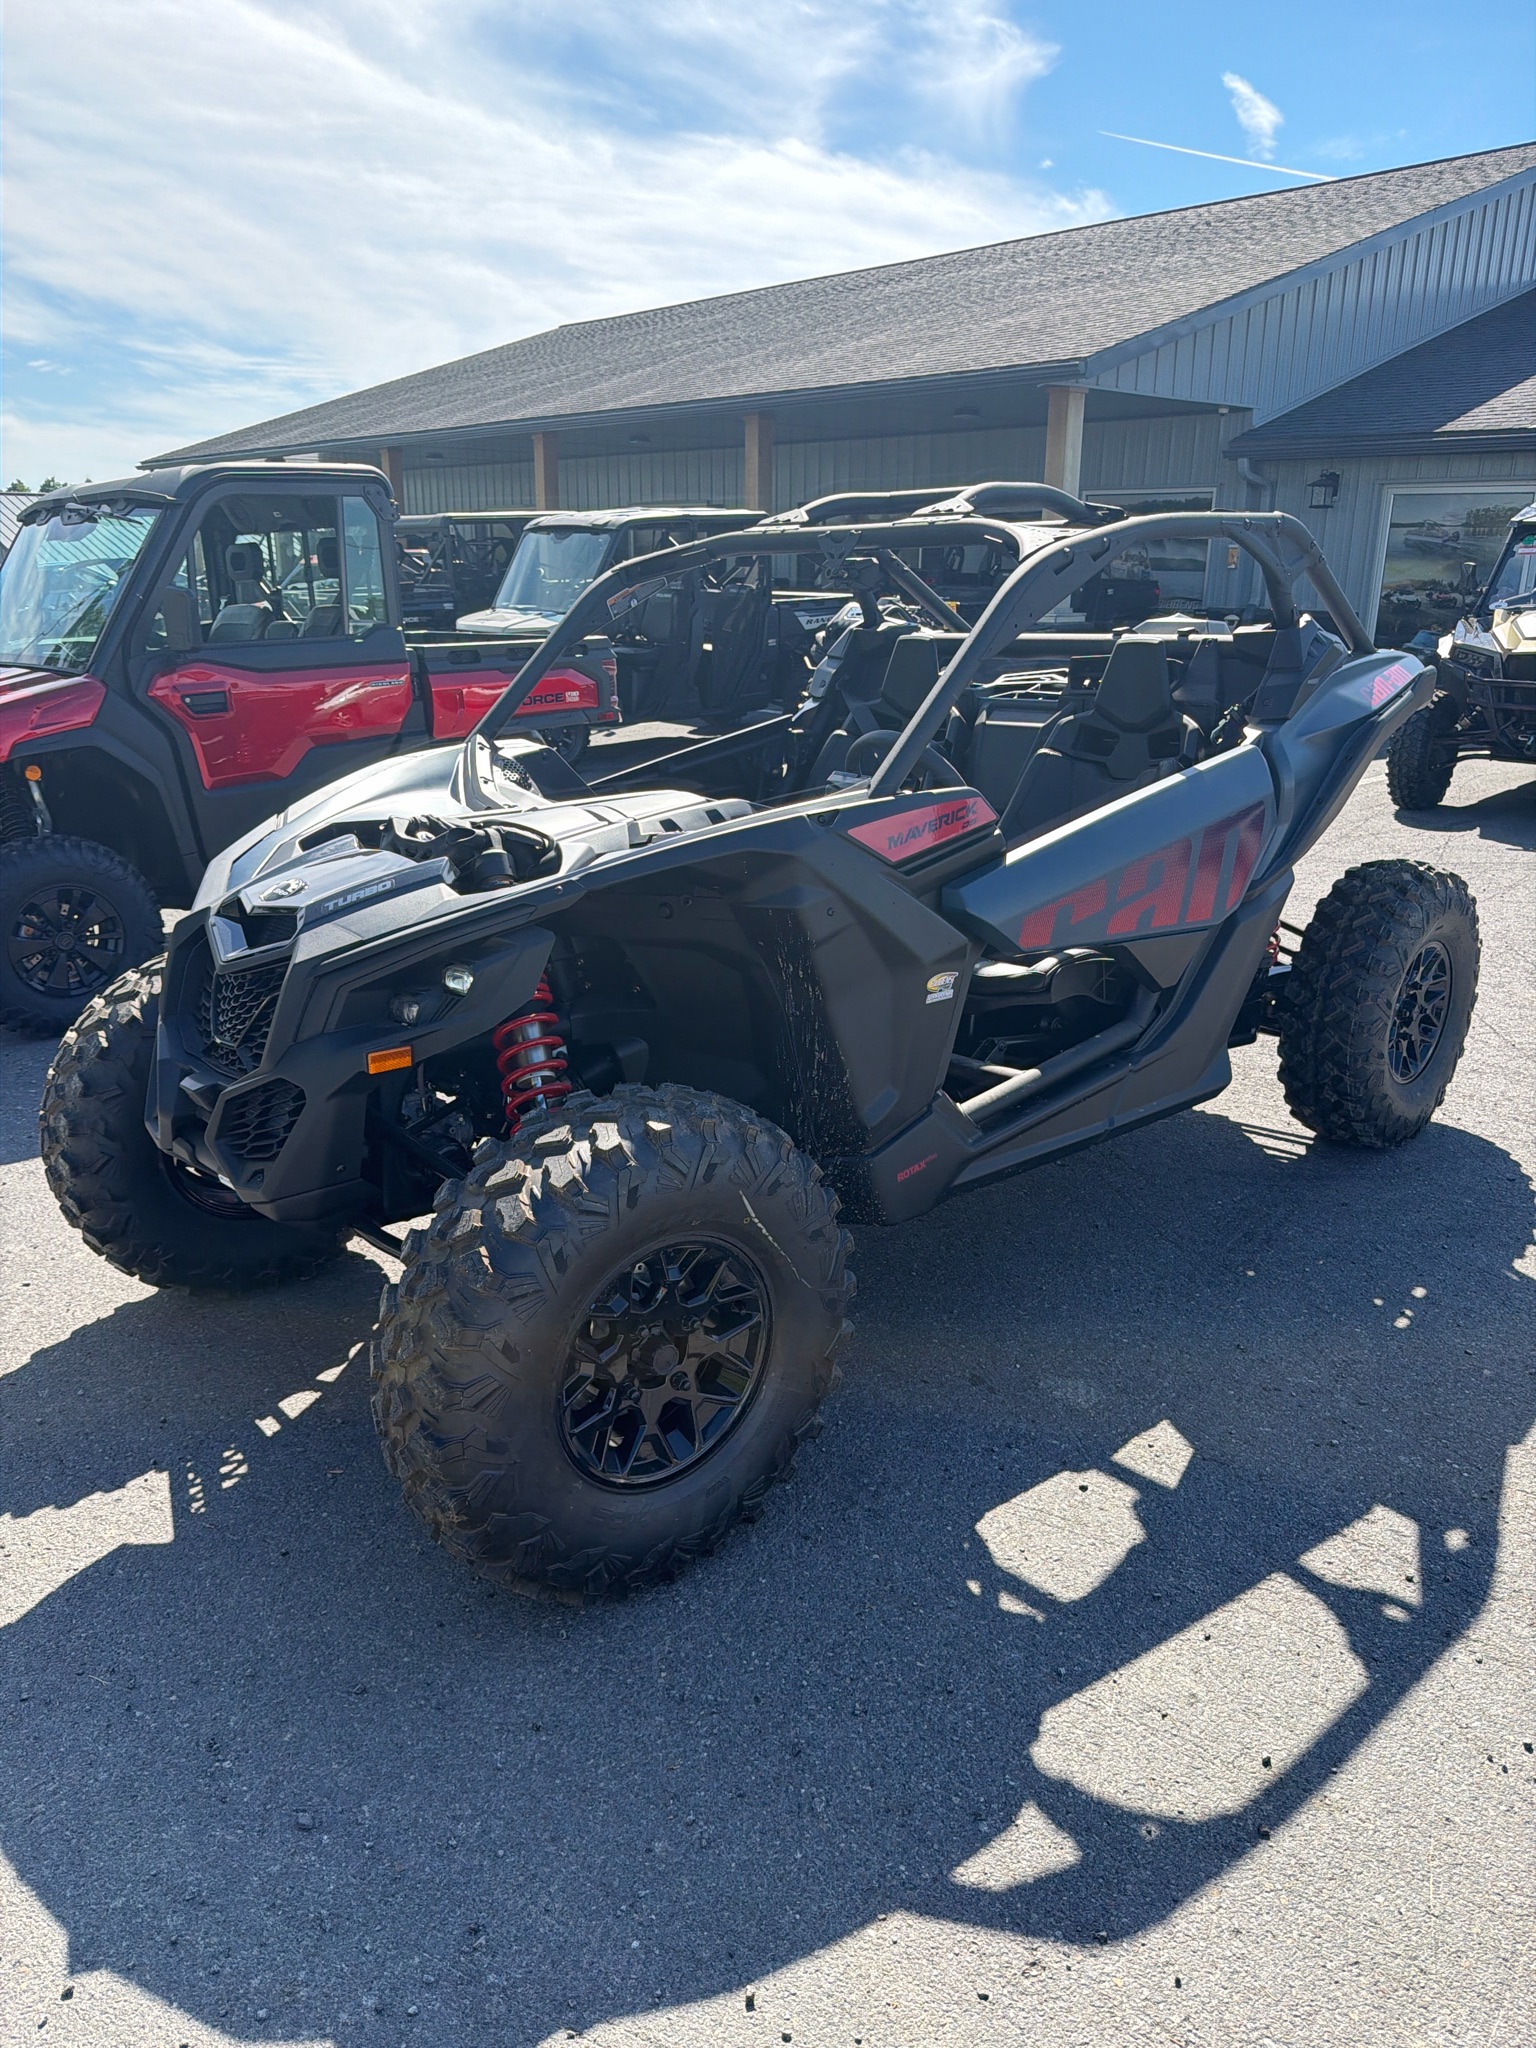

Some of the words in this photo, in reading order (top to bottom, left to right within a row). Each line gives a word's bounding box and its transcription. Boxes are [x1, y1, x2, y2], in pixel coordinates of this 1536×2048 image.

[522, 692, 564, 706] ORCE
[887, 801, 978, 850] MAVERICK
[324, 880, 392, 911] TURBO
[897, 1160, 926, 1182] ROTAX
